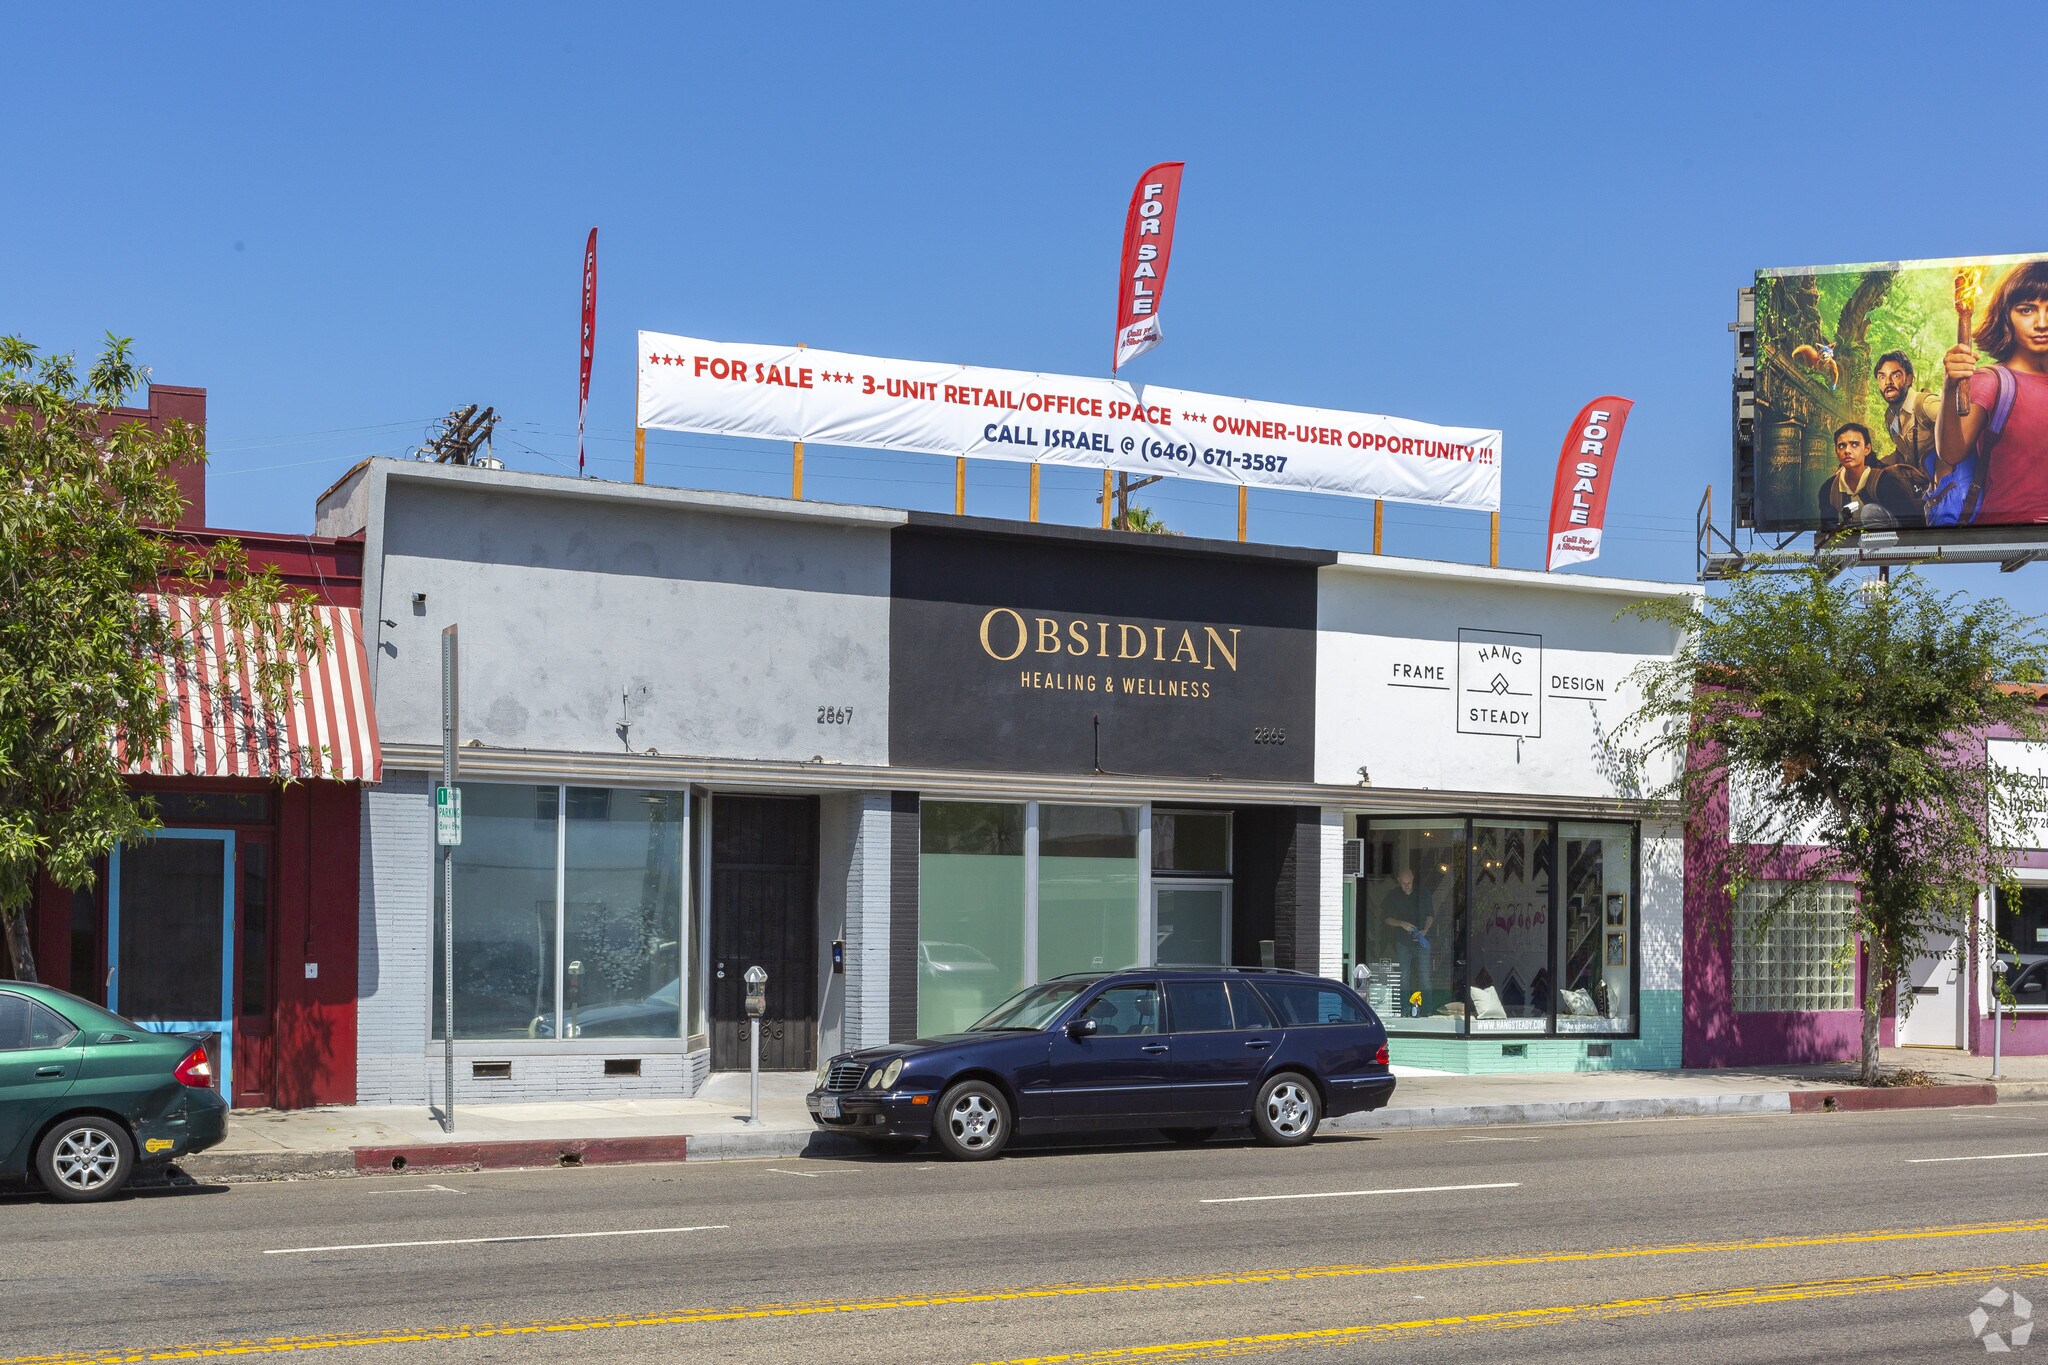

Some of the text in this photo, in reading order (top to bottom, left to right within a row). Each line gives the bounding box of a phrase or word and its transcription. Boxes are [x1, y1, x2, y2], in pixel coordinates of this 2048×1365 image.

[1132, 183, 1164, 316] FOR SALE
[695, 356, 1493, 466] FOR SALE 3-UNIT RETAIL/OFFICE SPACE OWNER-USER OPPORTUNITY !!!
[984, 423, 1288, 474] CALL ISRAEL @ (646) 671-3587
[1569, 410, 1610, 526] FOR SALE
[1562, 535, 1577, 543] Call
[979, 607, 1242, 672] OBSIDIAN
[1478, 644, 1522, 665] HANG
[1393, 663, 1445, 680] FRAME
[1020, 671, 1212, 699] HEALING & WELLNESS
[1552, 675, 1604, 692] DESIGN
[817, 705, 854, 725] 2867
[1469, 708, 1529, 725] STEADY
[1254, 727, 1286, 744] 2865
[438, 807, 460, 818] PARKING
[1477, 1019, 1547, 1031] WWW.HANGSTEADY.COM
